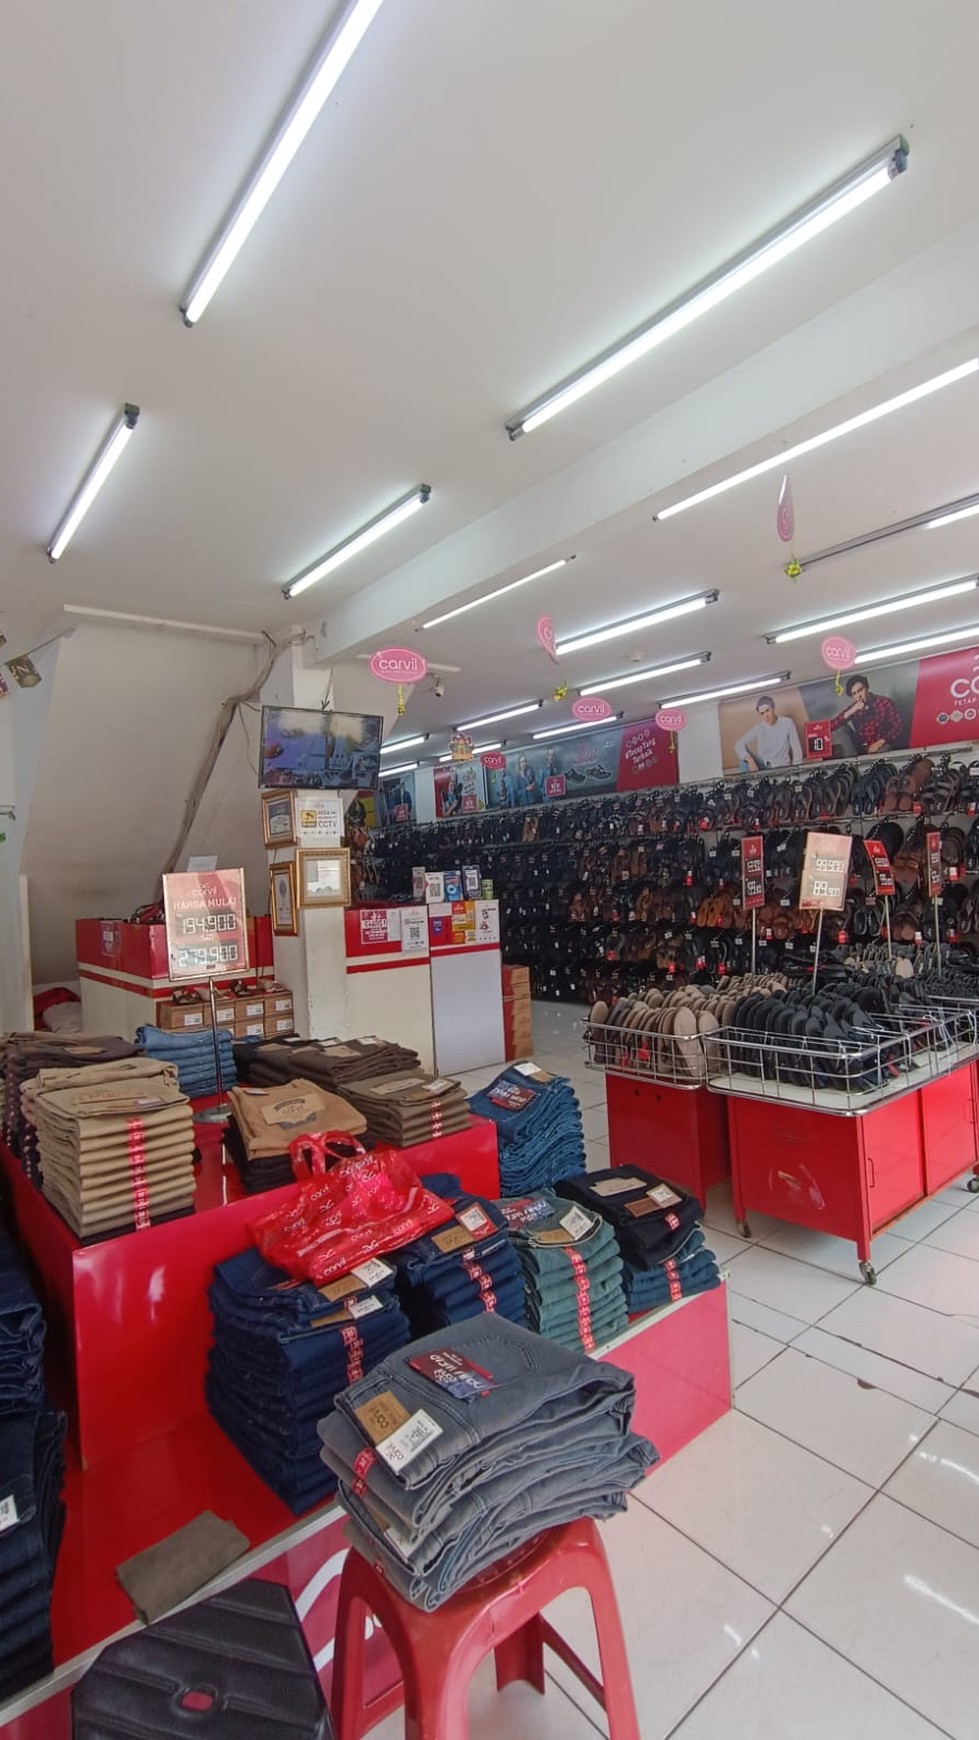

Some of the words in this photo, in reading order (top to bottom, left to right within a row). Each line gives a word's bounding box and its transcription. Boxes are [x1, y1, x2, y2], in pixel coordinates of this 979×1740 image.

[379, 657, 418, 671] carvil
[954, 697, 976, 706] TETAP
[578, 704, 604, 713] carvil
[484, 756, 502, 764] carvil
[318, 820, 337, 828] CCTV
[173, 899, 207, 912] HARGA
[207, 896, 237, 908] MULAI
[310, 1183, 329, 1201] carvil
[323, 1255, 347, 1277] carvil
